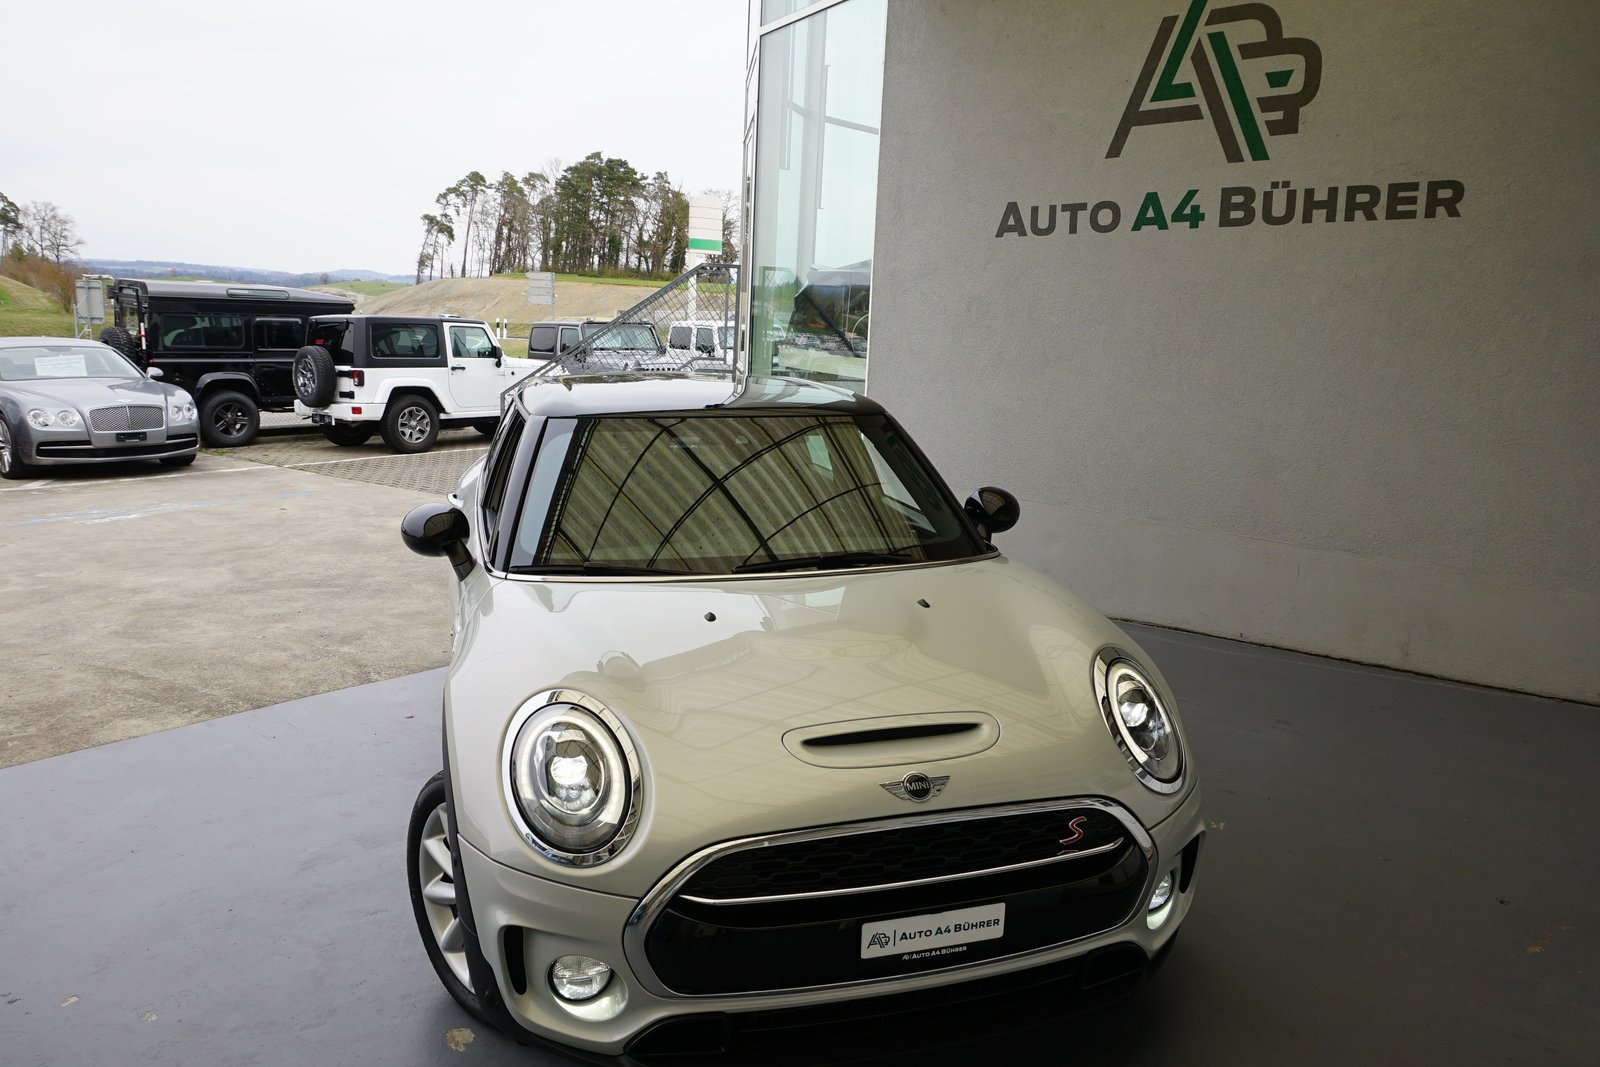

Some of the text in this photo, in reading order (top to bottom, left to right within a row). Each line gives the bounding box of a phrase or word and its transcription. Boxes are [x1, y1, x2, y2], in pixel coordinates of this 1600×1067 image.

[995, 179, 1465, 238] AUTO A4 BÜHRER
[906, 781, 930, 791] MINI
[1059, 815, 1087, 845] S
[899, 929, 933, 941] AUTO
[935, 925, 951, 937] A4
[954, 918, 1000, 933] BÜHRER
[912, 951, 931, 960] AUTO
[931, 949, 941, 957] A4
[941, 946, 967, 955] BÜHRER
